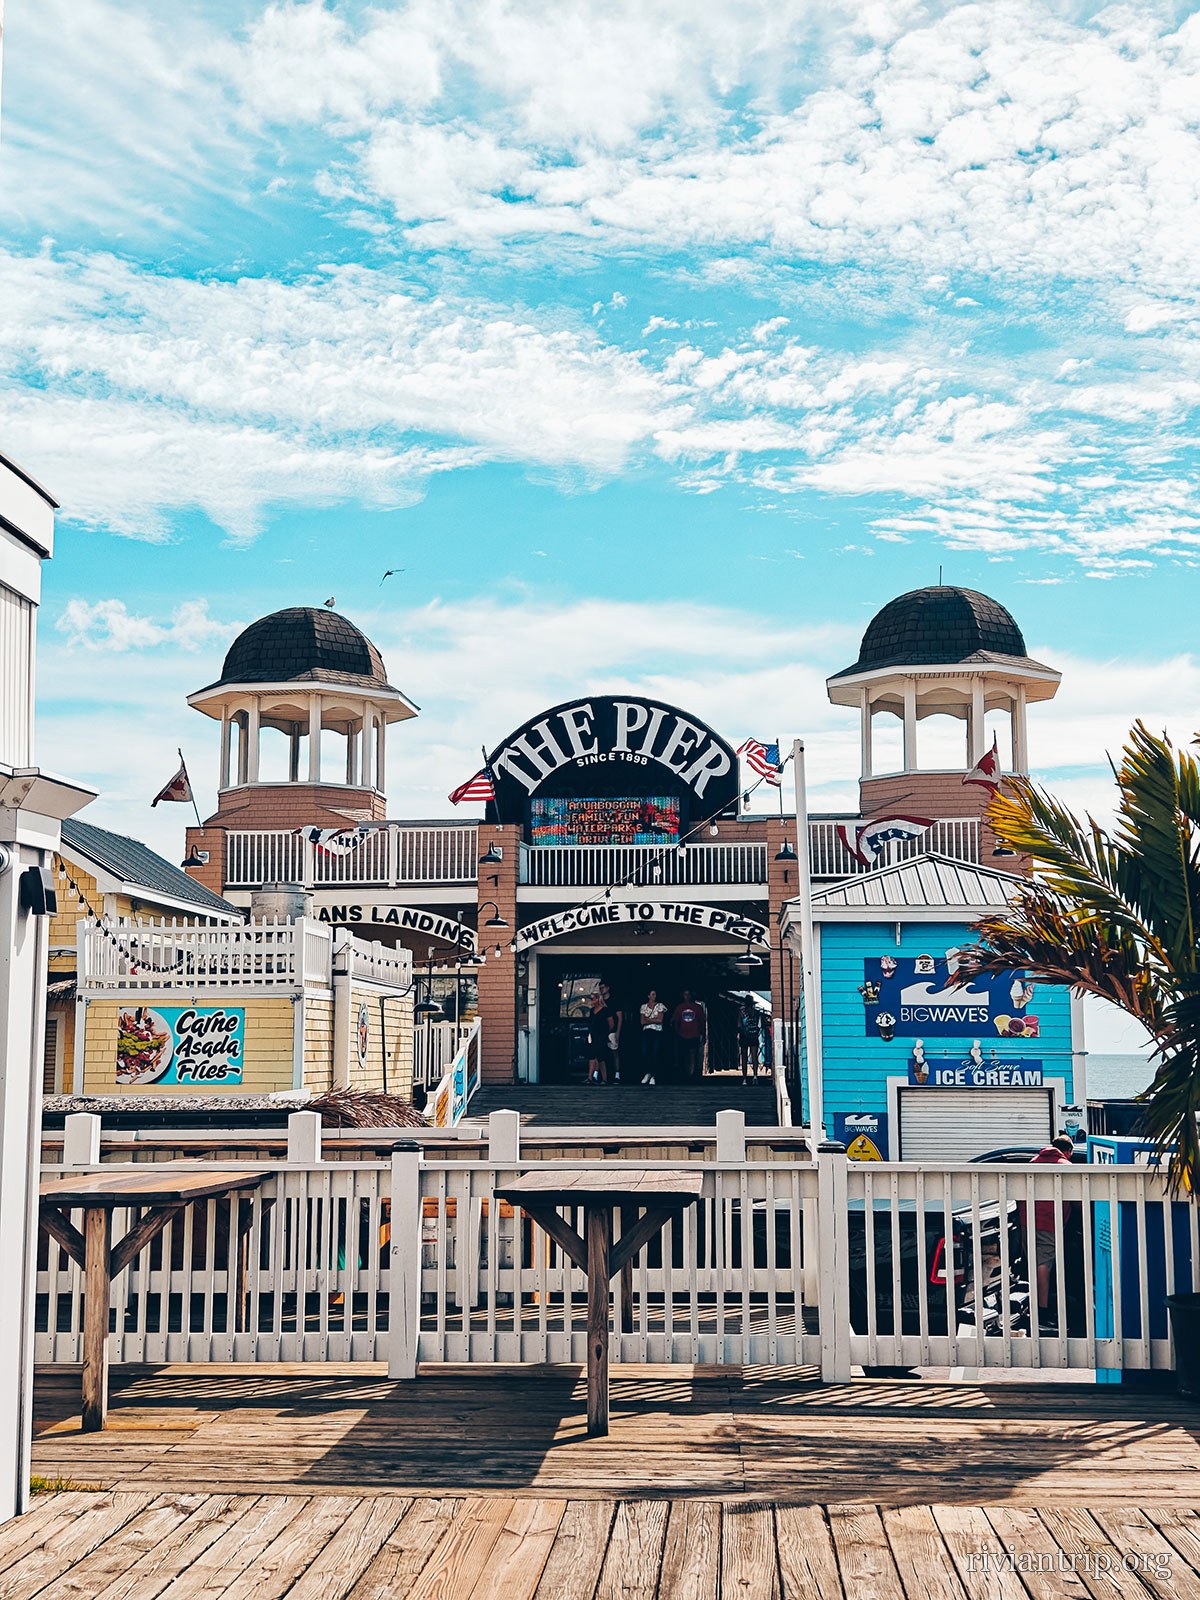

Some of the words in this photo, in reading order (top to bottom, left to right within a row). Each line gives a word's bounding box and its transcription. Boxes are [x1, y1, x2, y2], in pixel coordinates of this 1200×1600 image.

[492, 703, 598, 796] THE
[611, 702, 731, 799] PIER
[577, 752, 616, 767] SINCE
[619, 752, 648, 766] 1898
[571, 812, 612, 821] FAMILY
[618, 812, 639, 821] FUN
[313, 905, 362, 922] ANS
[372, 906, 474, 948] LANDING
[520, 905, 620, 943] WELCOME
[625, 904, 654, 920] TO
[660, 904, 704, 924] THE
[709, 911, 766, 943] PIER
[176, 1011, 238, 1037] Carne
[175, 1035, 239, 1058] Asada
[177, 1059, 240, 1080] Fries
[935, 1070, 966, 1085] ICE
[973, 1070, 1042, 1085] CREAM
[985, 1060, 1020, 1073] Serve
